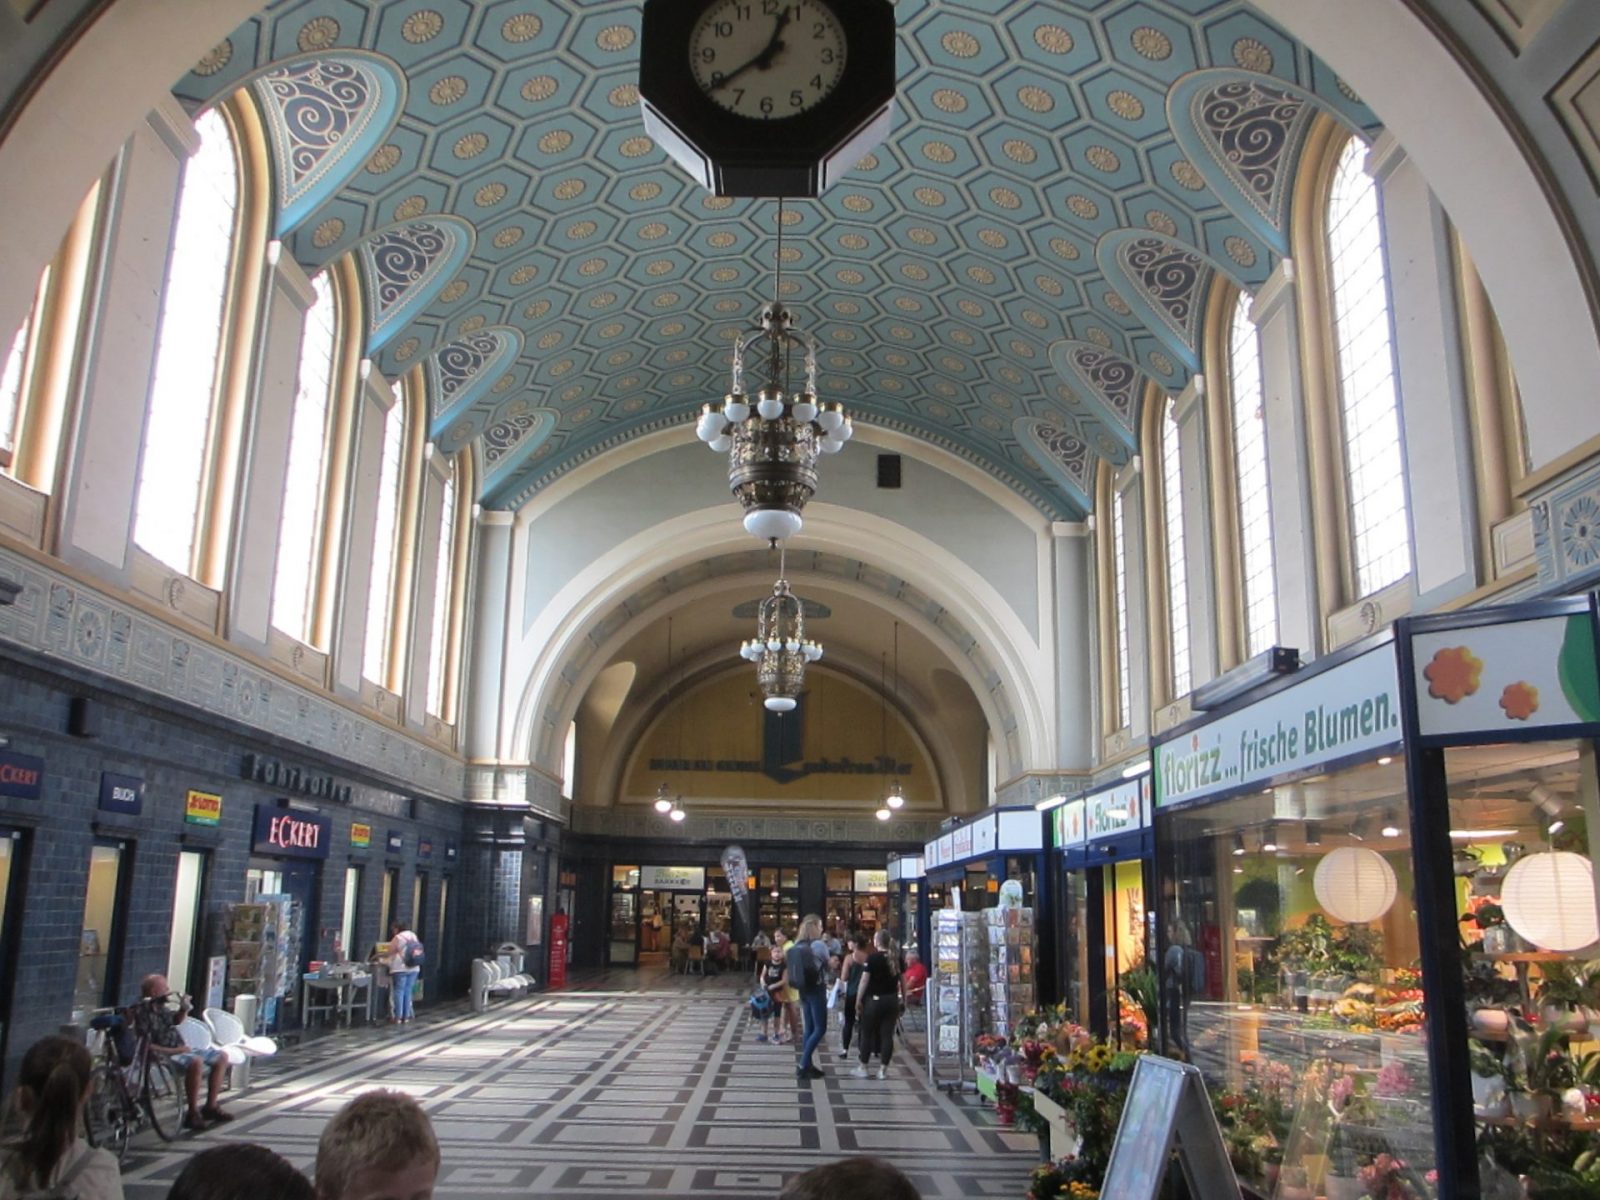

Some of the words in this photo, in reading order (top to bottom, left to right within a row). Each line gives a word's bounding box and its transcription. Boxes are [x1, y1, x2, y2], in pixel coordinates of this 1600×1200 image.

[737, 5, 751, 21] 11
[762, 0, 779, 15] 12
[794, 5, 801, 21] 1
[714, 21, 734, 38] 10
[812, 22, 826, 39] 2
[702, 46, 716, 64] 9
[820, 47, 834, 65] 3
[809, 73, 822, 90] 4
[732, 88, 746, 106] 7
[759, 96, 774, 114] 6
[789, 90, 804, 107] 5
[1164, 734, 1222, 797] florizz
[1304, 692, 1398, 754] Blumen.
[0, 764, 39, 786] CKERT
[112, 786, 135, 802] BUCH
[269, 815, 320, 849] ECKERT
